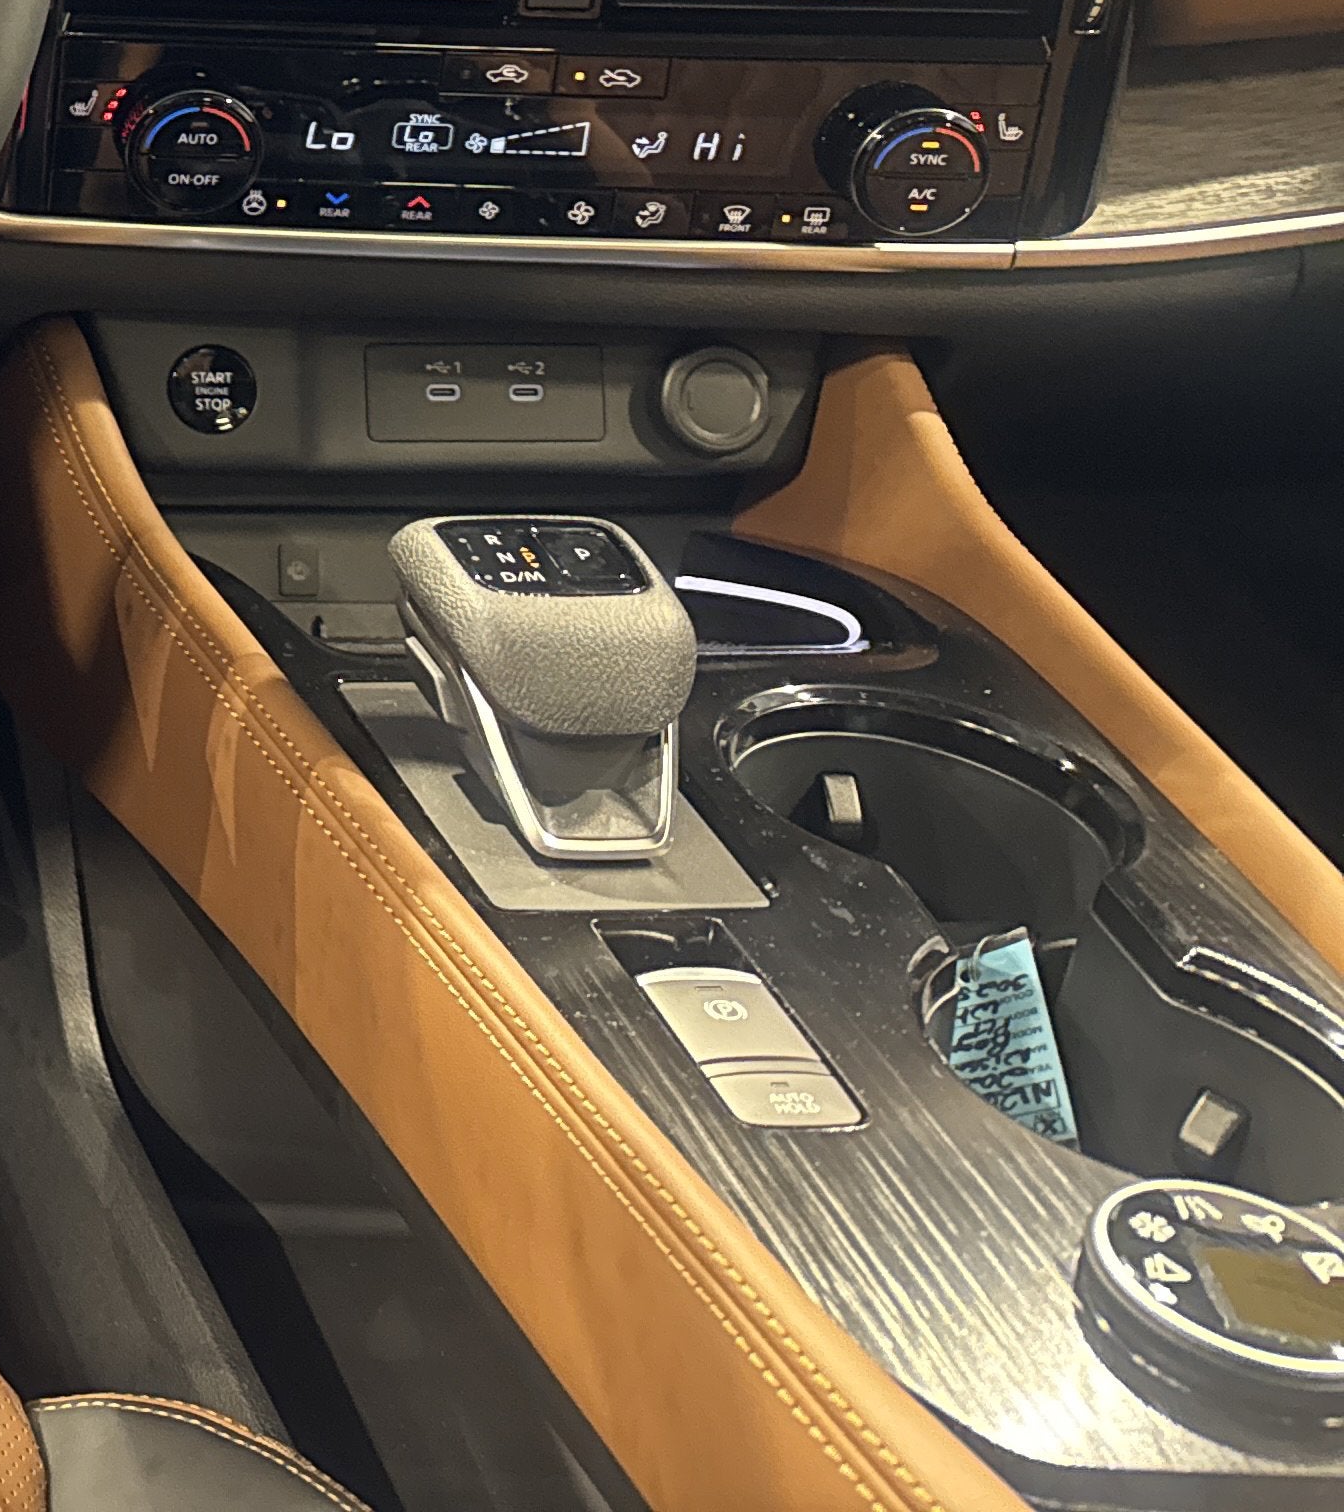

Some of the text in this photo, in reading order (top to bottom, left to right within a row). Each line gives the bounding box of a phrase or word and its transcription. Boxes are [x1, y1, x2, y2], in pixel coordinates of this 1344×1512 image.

[409, 113, 442, 124] SYNC
[176, 133, 219, 146] AUTO
[304, 121, 356, 151] Lo
[403, 125, 435, 143] Lo
[405, 142, 439, 153] REAR
[909, 153, 949, 166] SYNC
[907, 188, 938, 201] A/C
[319, 207, 351, 218] REAR
[400, 210, 433, 221] REAR
[717, 223, 753, 234] FRONT
[800, 225, 828, 235] REAR
[453, 361, 461, 374] 1
[534, 361, 546, 376] 2
[190, 371, 233, 384] START
[194, 385, 229, 396] ENGINE
[195, 398, 232, 412] STOP
[483, 534, 503, 546] R
[495, 551, 517, 564] N
[573, 547, 591, 561] P
[499, 570, 547, 583] D/M
[769, 1091, 815, 1104] AUTO
[774, 1102, 821, 1115] HOLD
